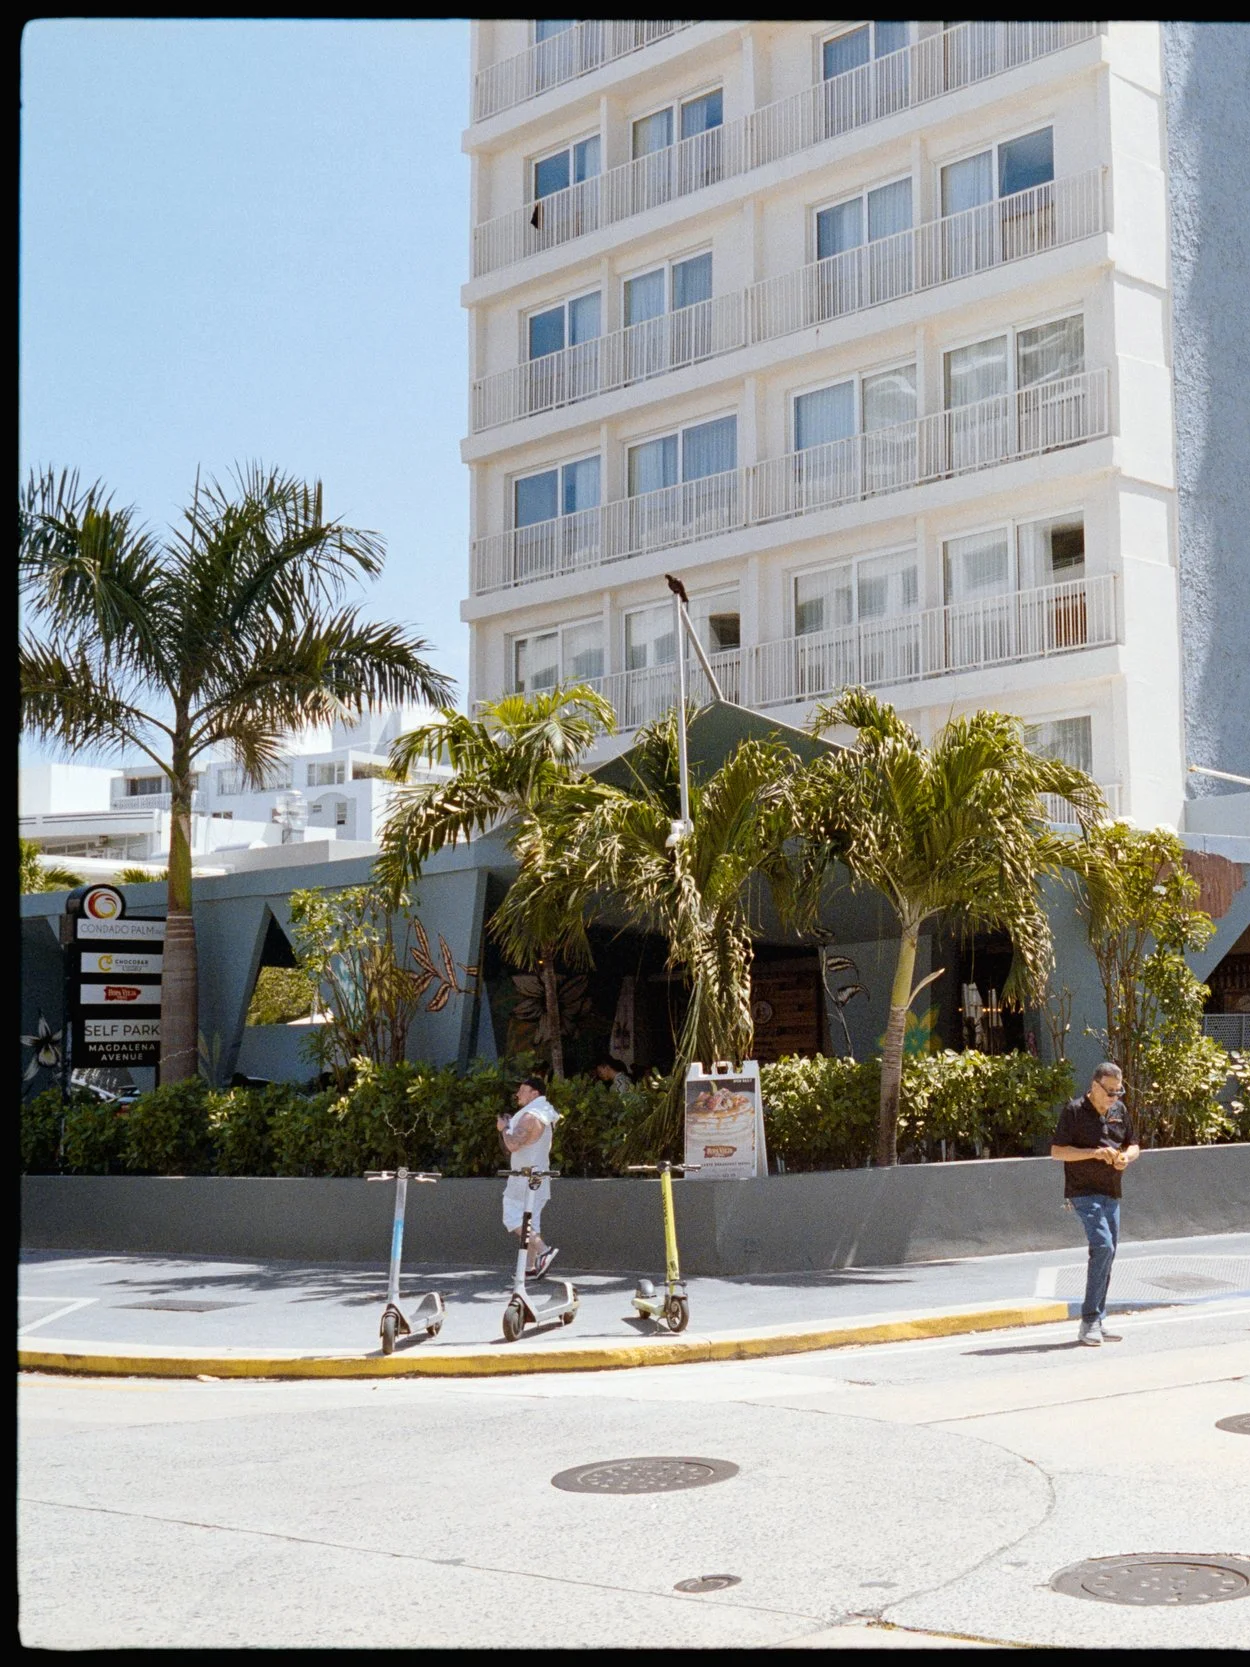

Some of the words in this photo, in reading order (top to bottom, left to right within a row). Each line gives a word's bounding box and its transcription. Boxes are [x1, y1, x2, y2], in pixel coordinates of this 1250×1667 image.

[80, 923, 130, 934] CONDADO
[131, 925, 155, 935] PALM
[84, 1024, 119, 1037] SELF
[89, 1043, 155, 1052] MAGDALENA
[101, 1053, 143, 1061] AVENUE
